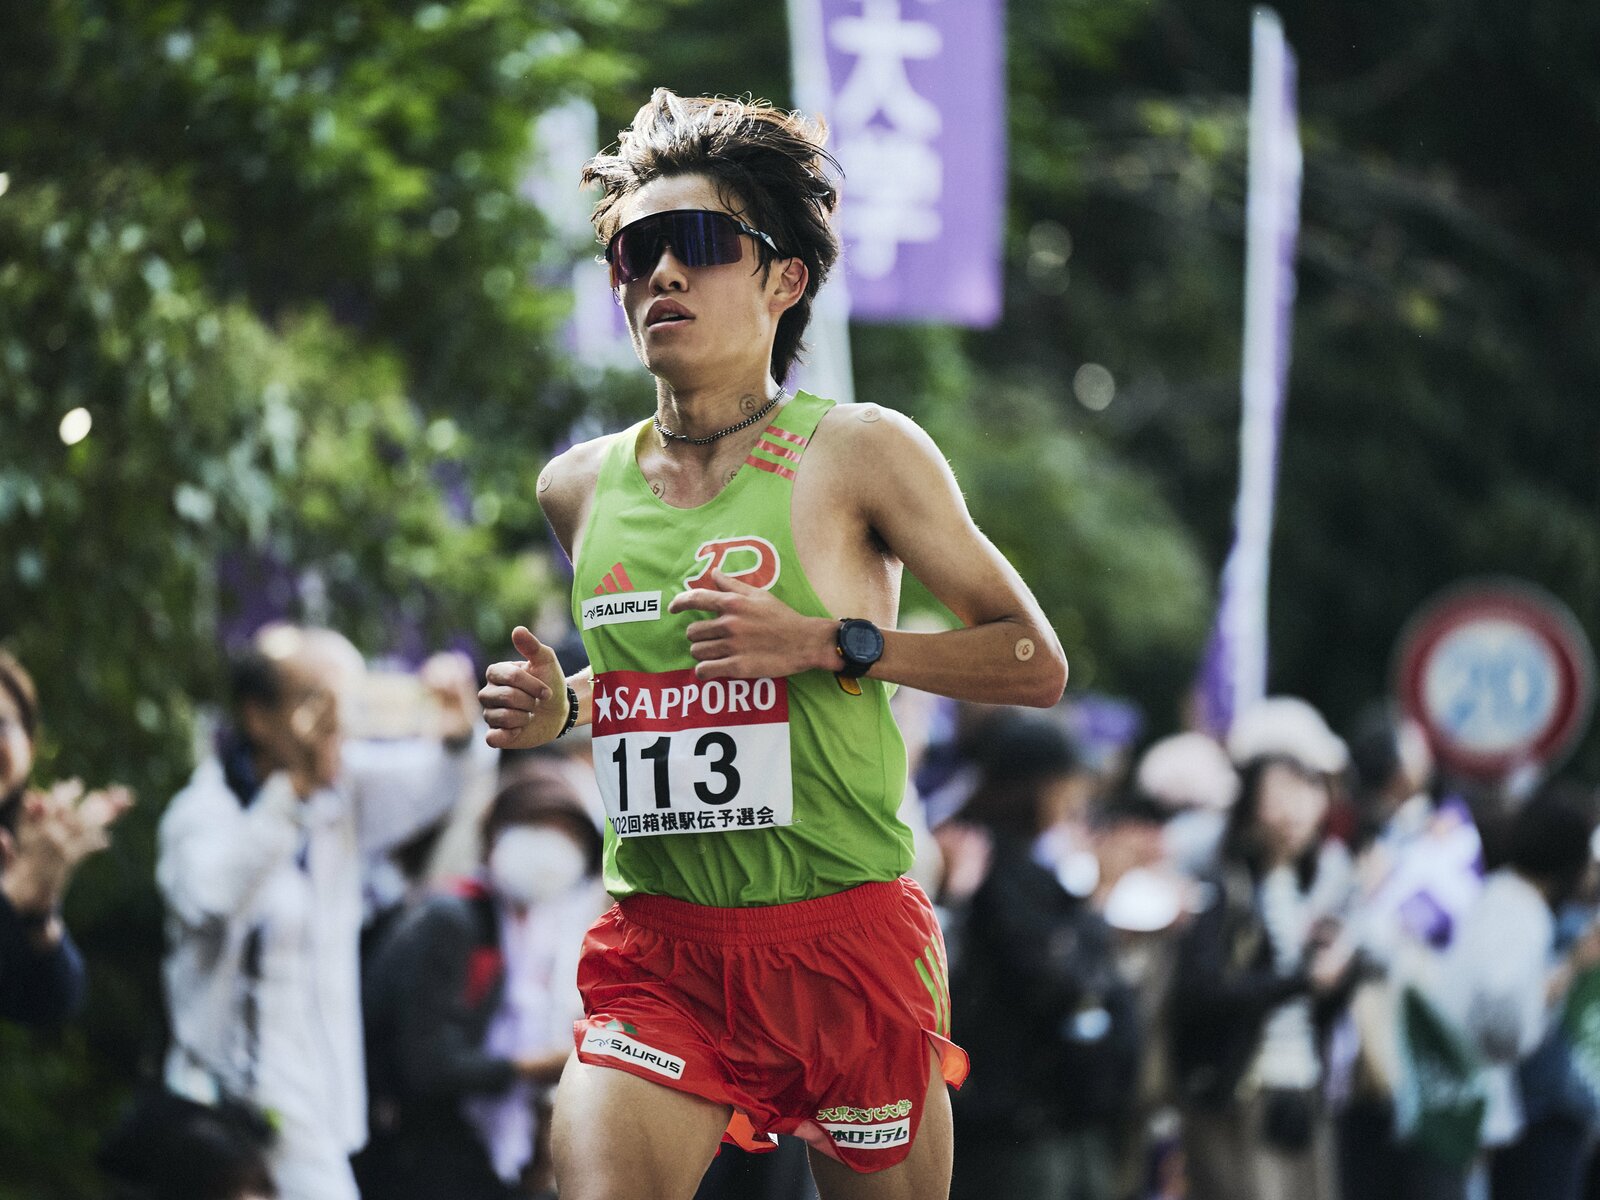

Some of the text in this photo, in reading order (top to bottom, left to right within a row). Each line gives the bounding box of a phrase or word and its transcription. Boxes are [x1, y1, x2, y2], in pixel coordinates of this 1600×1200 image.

[596, 600, 658, 617] SAURUS
[615, 678, 776, 721] SAPPORO
[612, 731, 741, 812] 113
[608, 805, 774, 834] 102回箱根駅伝予選会
[610, 1038, 681, 1074] SAURUS
[827, 1126, 908, 1145] 本ロジテム
